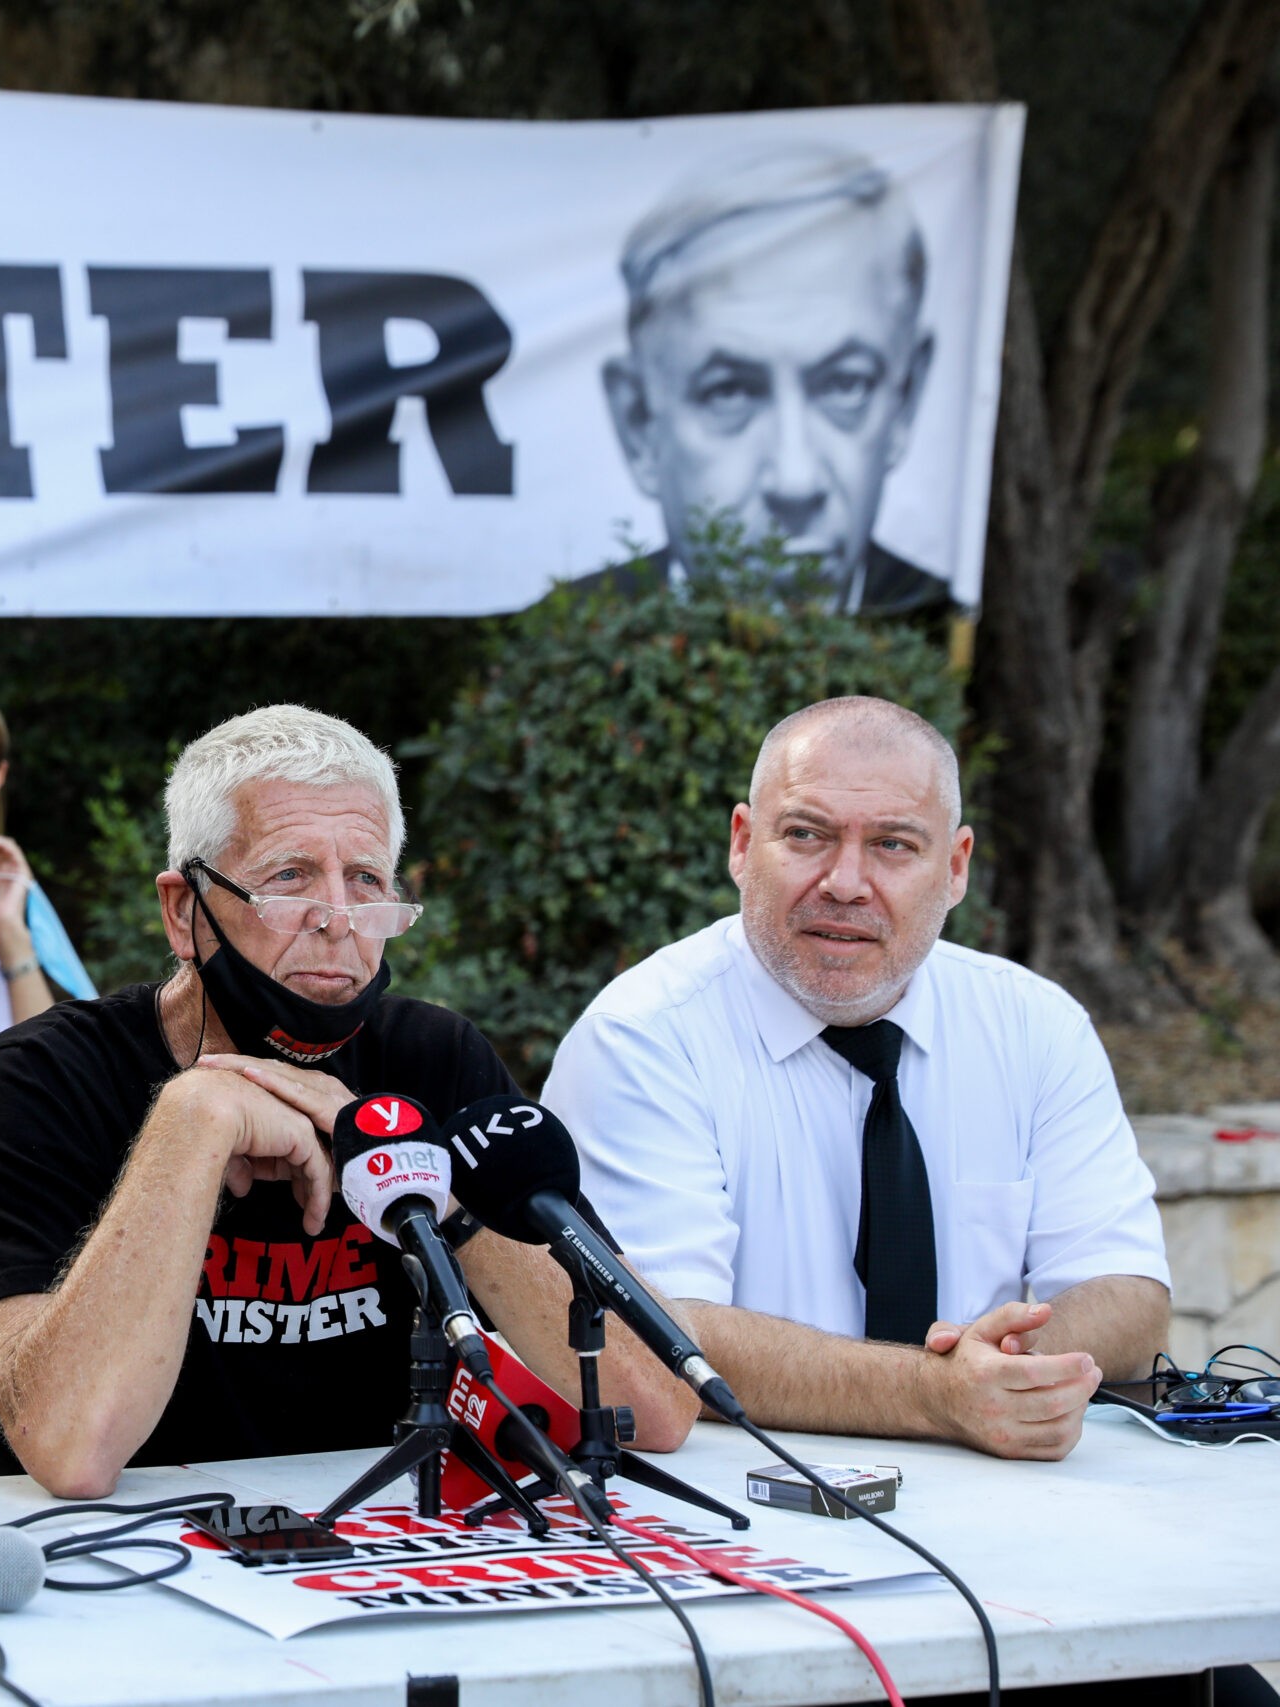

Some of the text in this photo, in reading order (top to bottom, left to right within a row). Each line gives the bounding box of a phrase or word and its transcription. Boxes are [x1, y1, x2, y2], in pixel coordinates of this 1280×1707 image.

[196, 1223, 379, 1302] RIME
[572, 1235, 615, 1283] SENNHEISER
[196, 1287, 387, 1344] NISTER
[463, 1393, 488, 1430] 12
[858, 1490, 885, 1502] MARLBORO
[292, 1545, 805, 1592] CRIME
